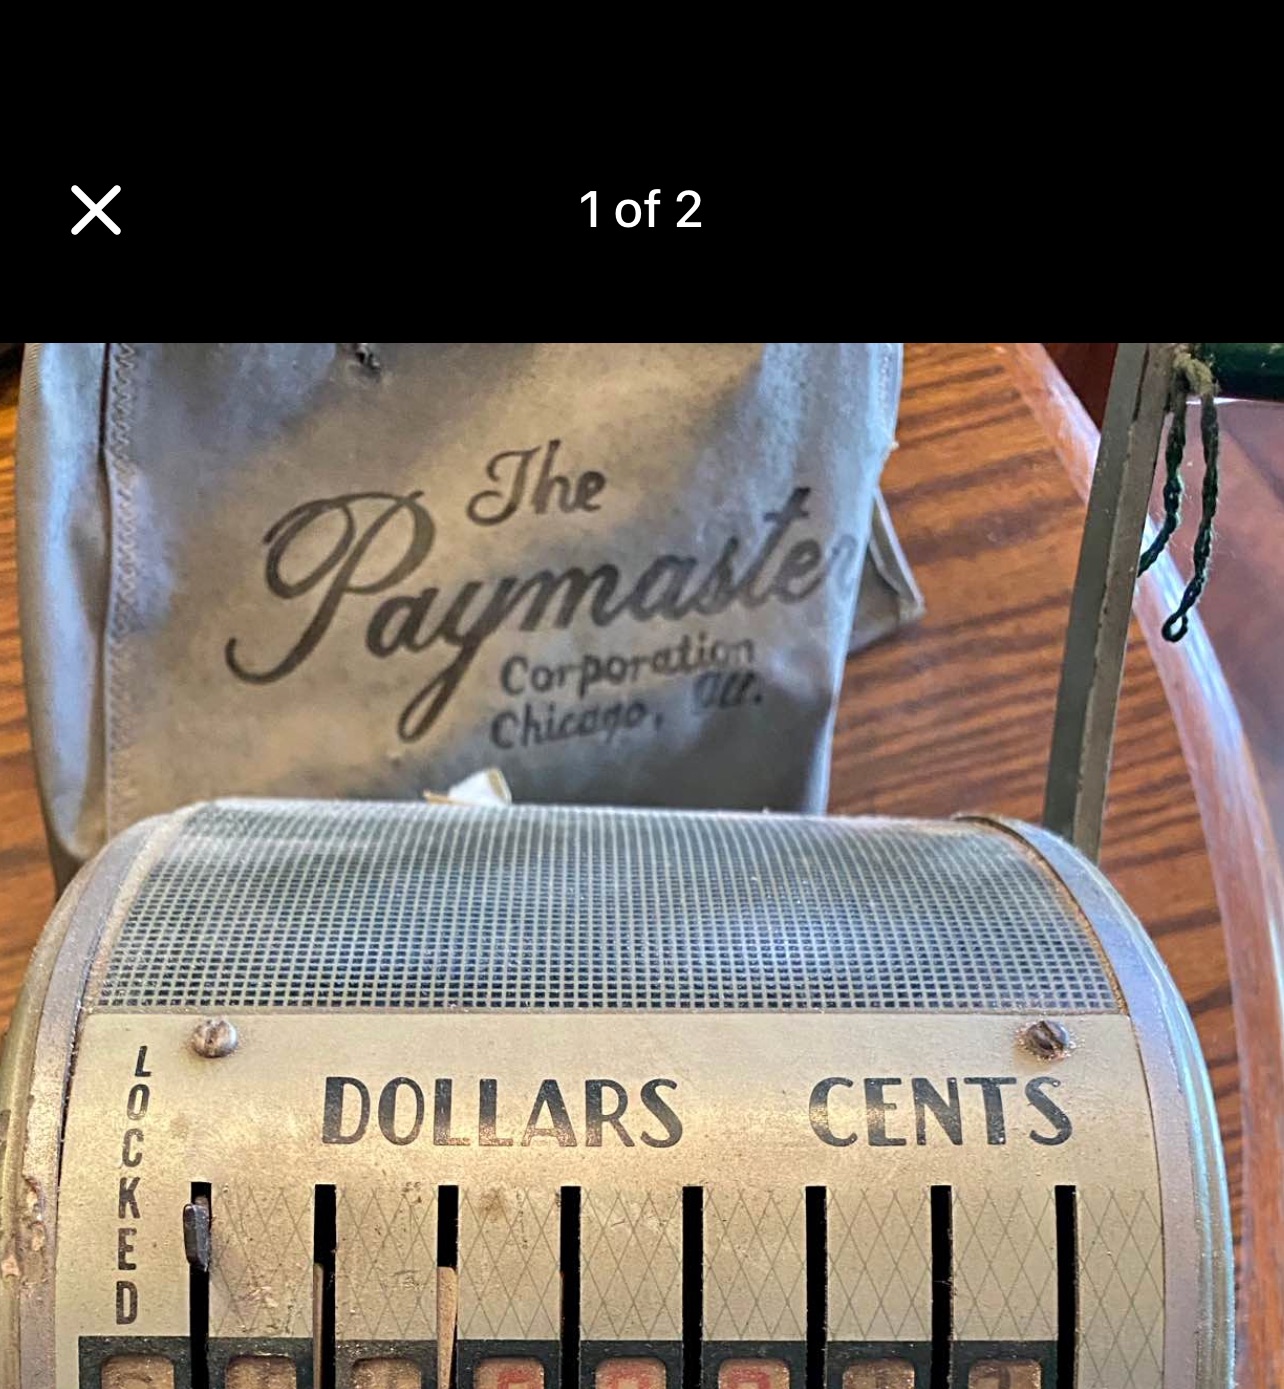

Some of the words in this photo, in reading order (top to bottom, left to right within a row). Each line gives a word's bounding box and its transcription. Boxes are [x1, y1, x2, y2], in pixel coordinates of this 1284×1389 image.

[468, 440, 606, 526] The
[225, 486, 858, 744] Paymaster
[501, 631, 755, 698] Corporation
[490, 701, 664, 749] Chicago,
[320, 1076, 684, 1149] DOLLARS
[807, 1076, 1074, 1147] CENTS
[114, 1044, 152, 1326] LOCKED
